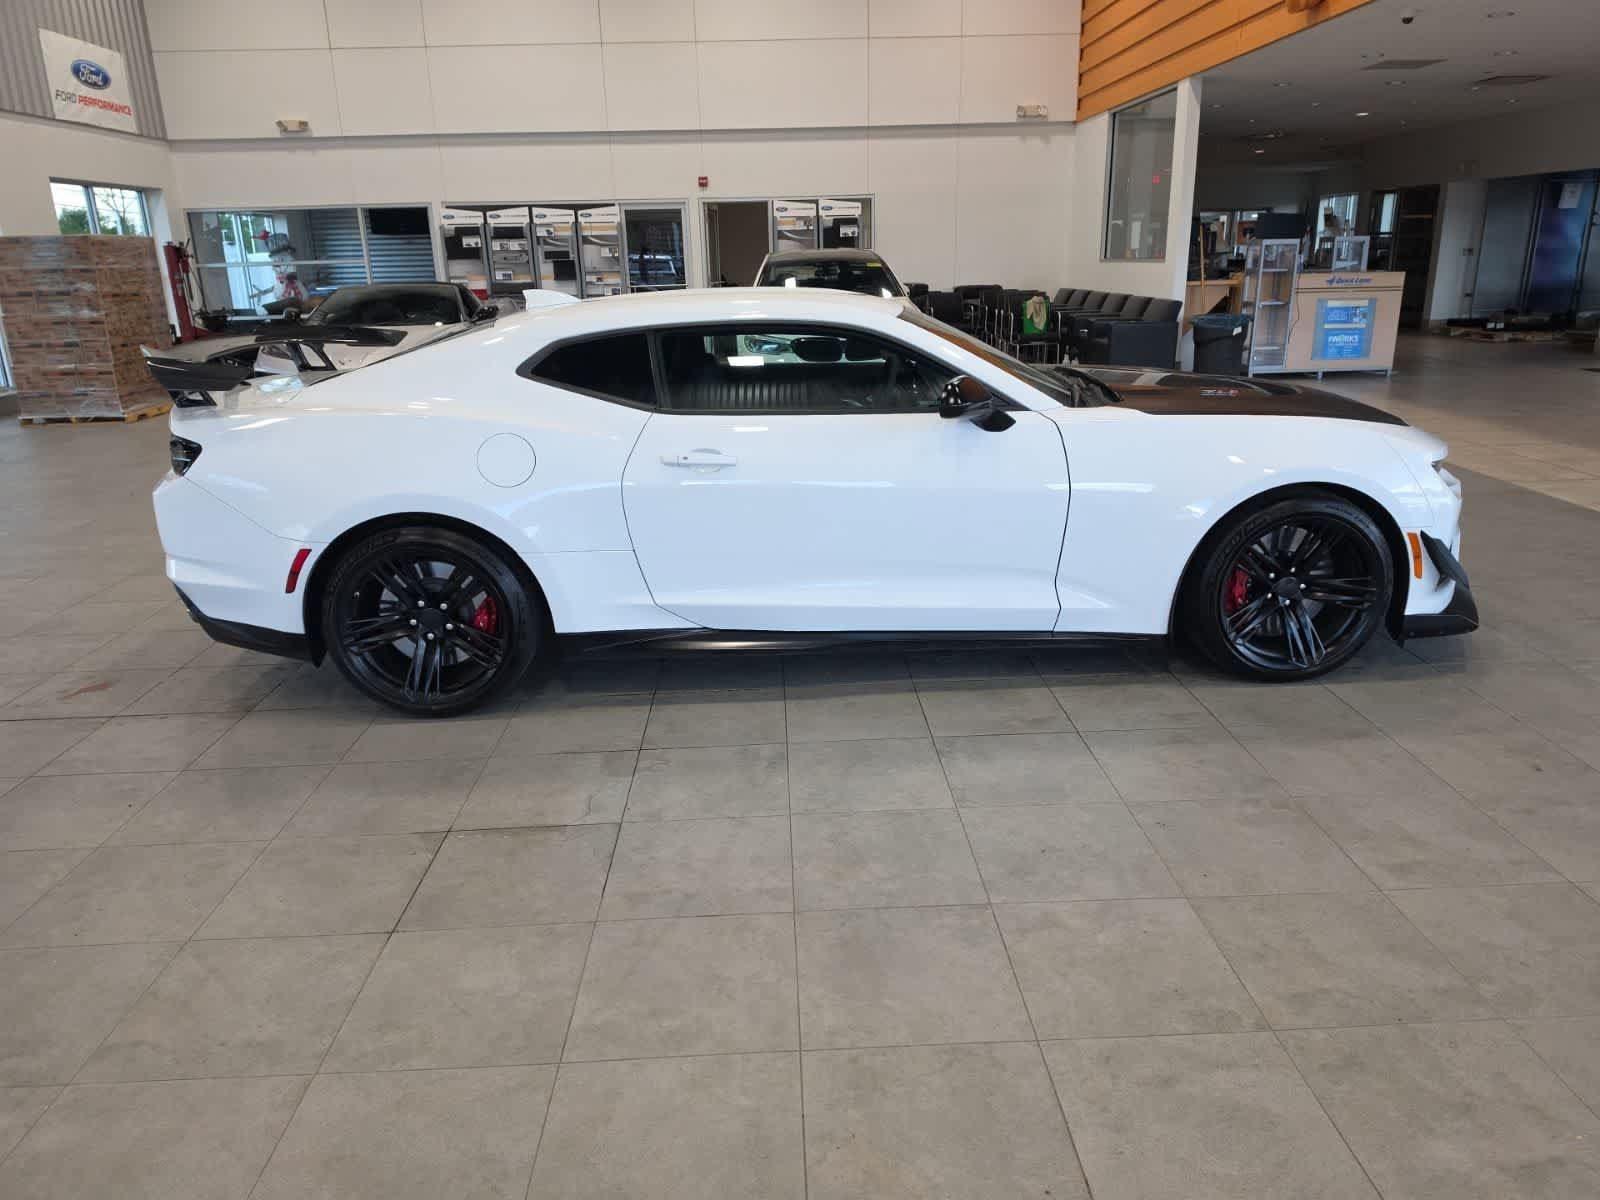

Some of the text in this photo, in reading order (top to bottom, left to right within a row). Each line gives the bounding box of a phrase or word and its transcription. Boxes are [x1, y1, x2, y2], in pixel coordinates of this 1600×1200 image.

[79, 63, 104, 85] Ford
[55, 89, 132, 116] FORD PERFORMANCE
